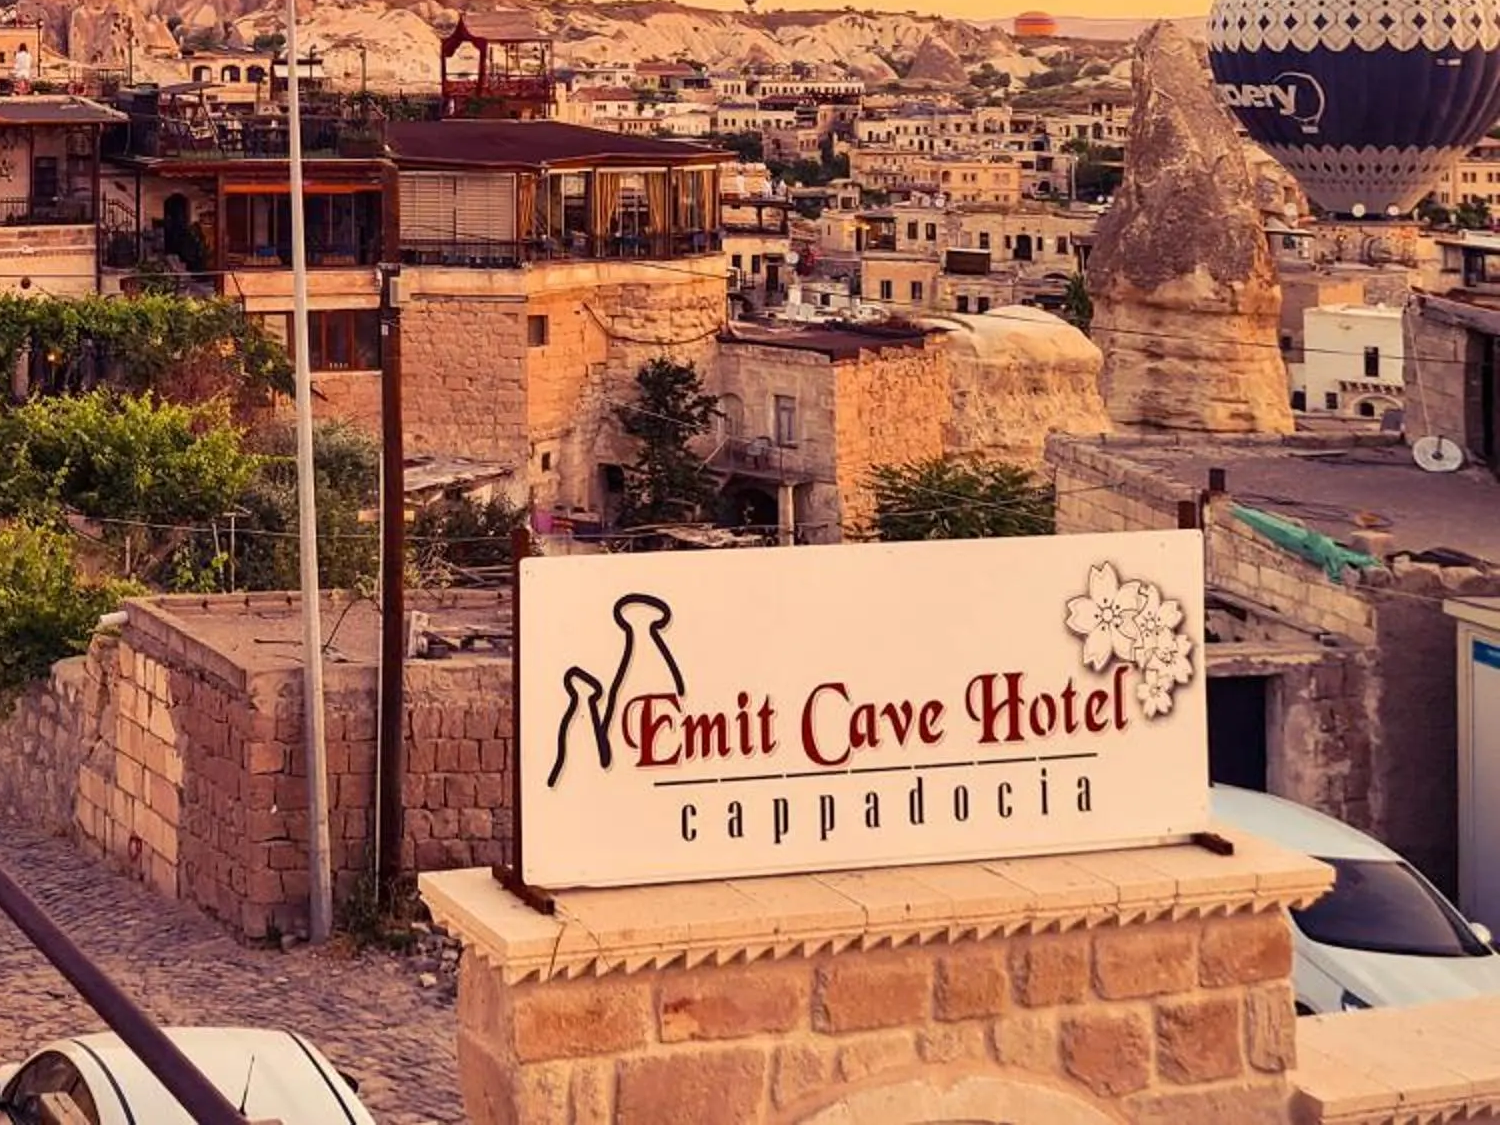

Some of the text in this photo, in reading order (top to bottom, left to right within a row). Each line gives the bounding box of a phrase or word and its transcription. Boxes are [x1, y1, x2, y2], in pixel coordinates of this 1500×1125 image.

[622, 665, 1131, 768] Emit Cave Hotel
[681, 768, 1093, 844] cappadocia
